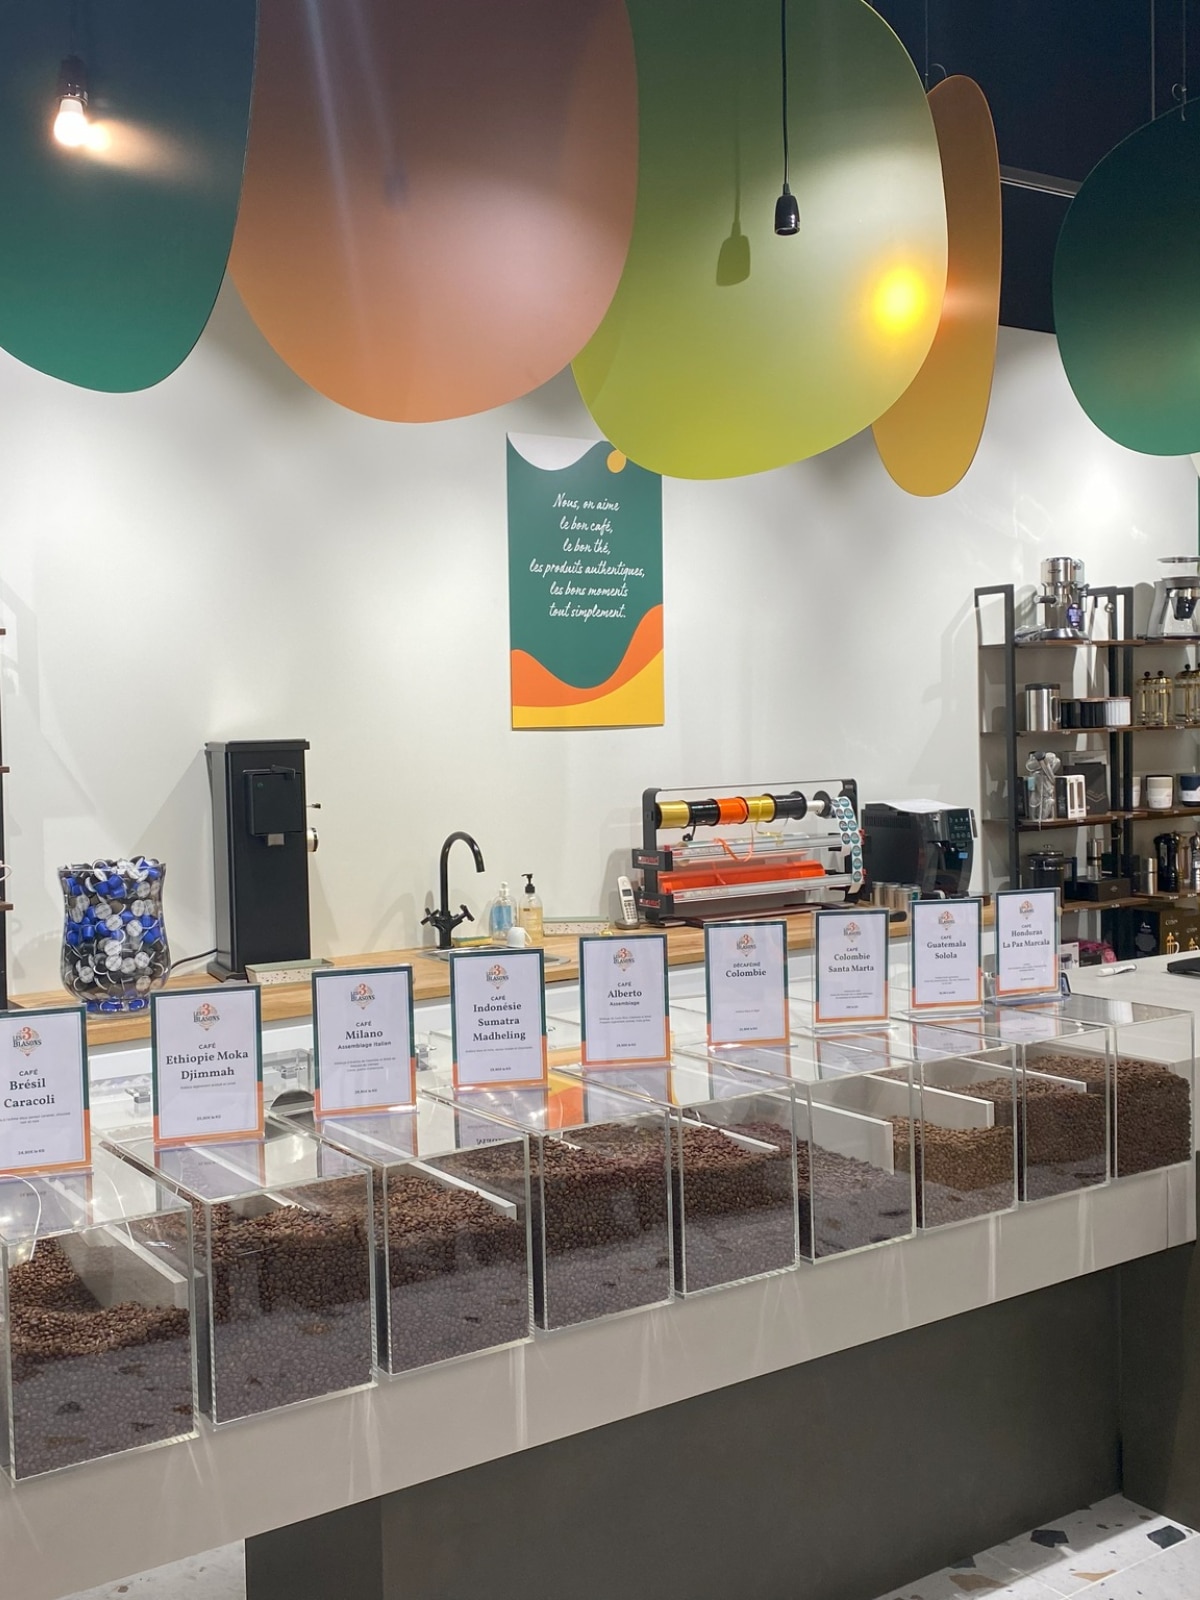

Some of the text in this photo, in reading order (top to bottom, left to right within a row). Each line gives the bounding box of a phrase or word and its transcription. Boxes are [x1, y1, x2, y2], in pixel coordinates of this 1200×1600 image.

[552, 492, 620, 511] Nous, on aime
[560, 516, 613, 536] le bon café,
[563, 538, 611, 555] le bon thé,
[530, 558, 645, 581] les produits authentiques,
[550, 581, 628, 597] les bons moments
[549, 602, 626, 622] tout simplement.
[1011, 929, 1042, 937] Honduras
[927, 940, 966, 948] Guatemala
[834, 953, 870, 961] Colombie
[494, 964, 501, 976] 3
[726, 969, 766, 977] Colombie
[359, 984, 366, 995] 3
[608, 990, 642, 998] Alberto
[202, 1003, 210, 1016] 3
[473, 1002, 522, 1012] Indonésie
[478, 1018, 520, 1026] Sumatra
[22, 1027, 31, 1040] 3
[345, 1030, 383, 1040] Milano
[473, 1031, 526, 1042] Madheling
[166, 1050, 249, 1065] Ethiopie Moka
[181, 1067, 235, 1081] Djimmah
[10, 1078, 46, 1090] Brésil
[4, 1095, 55, 1108] Caracoli
